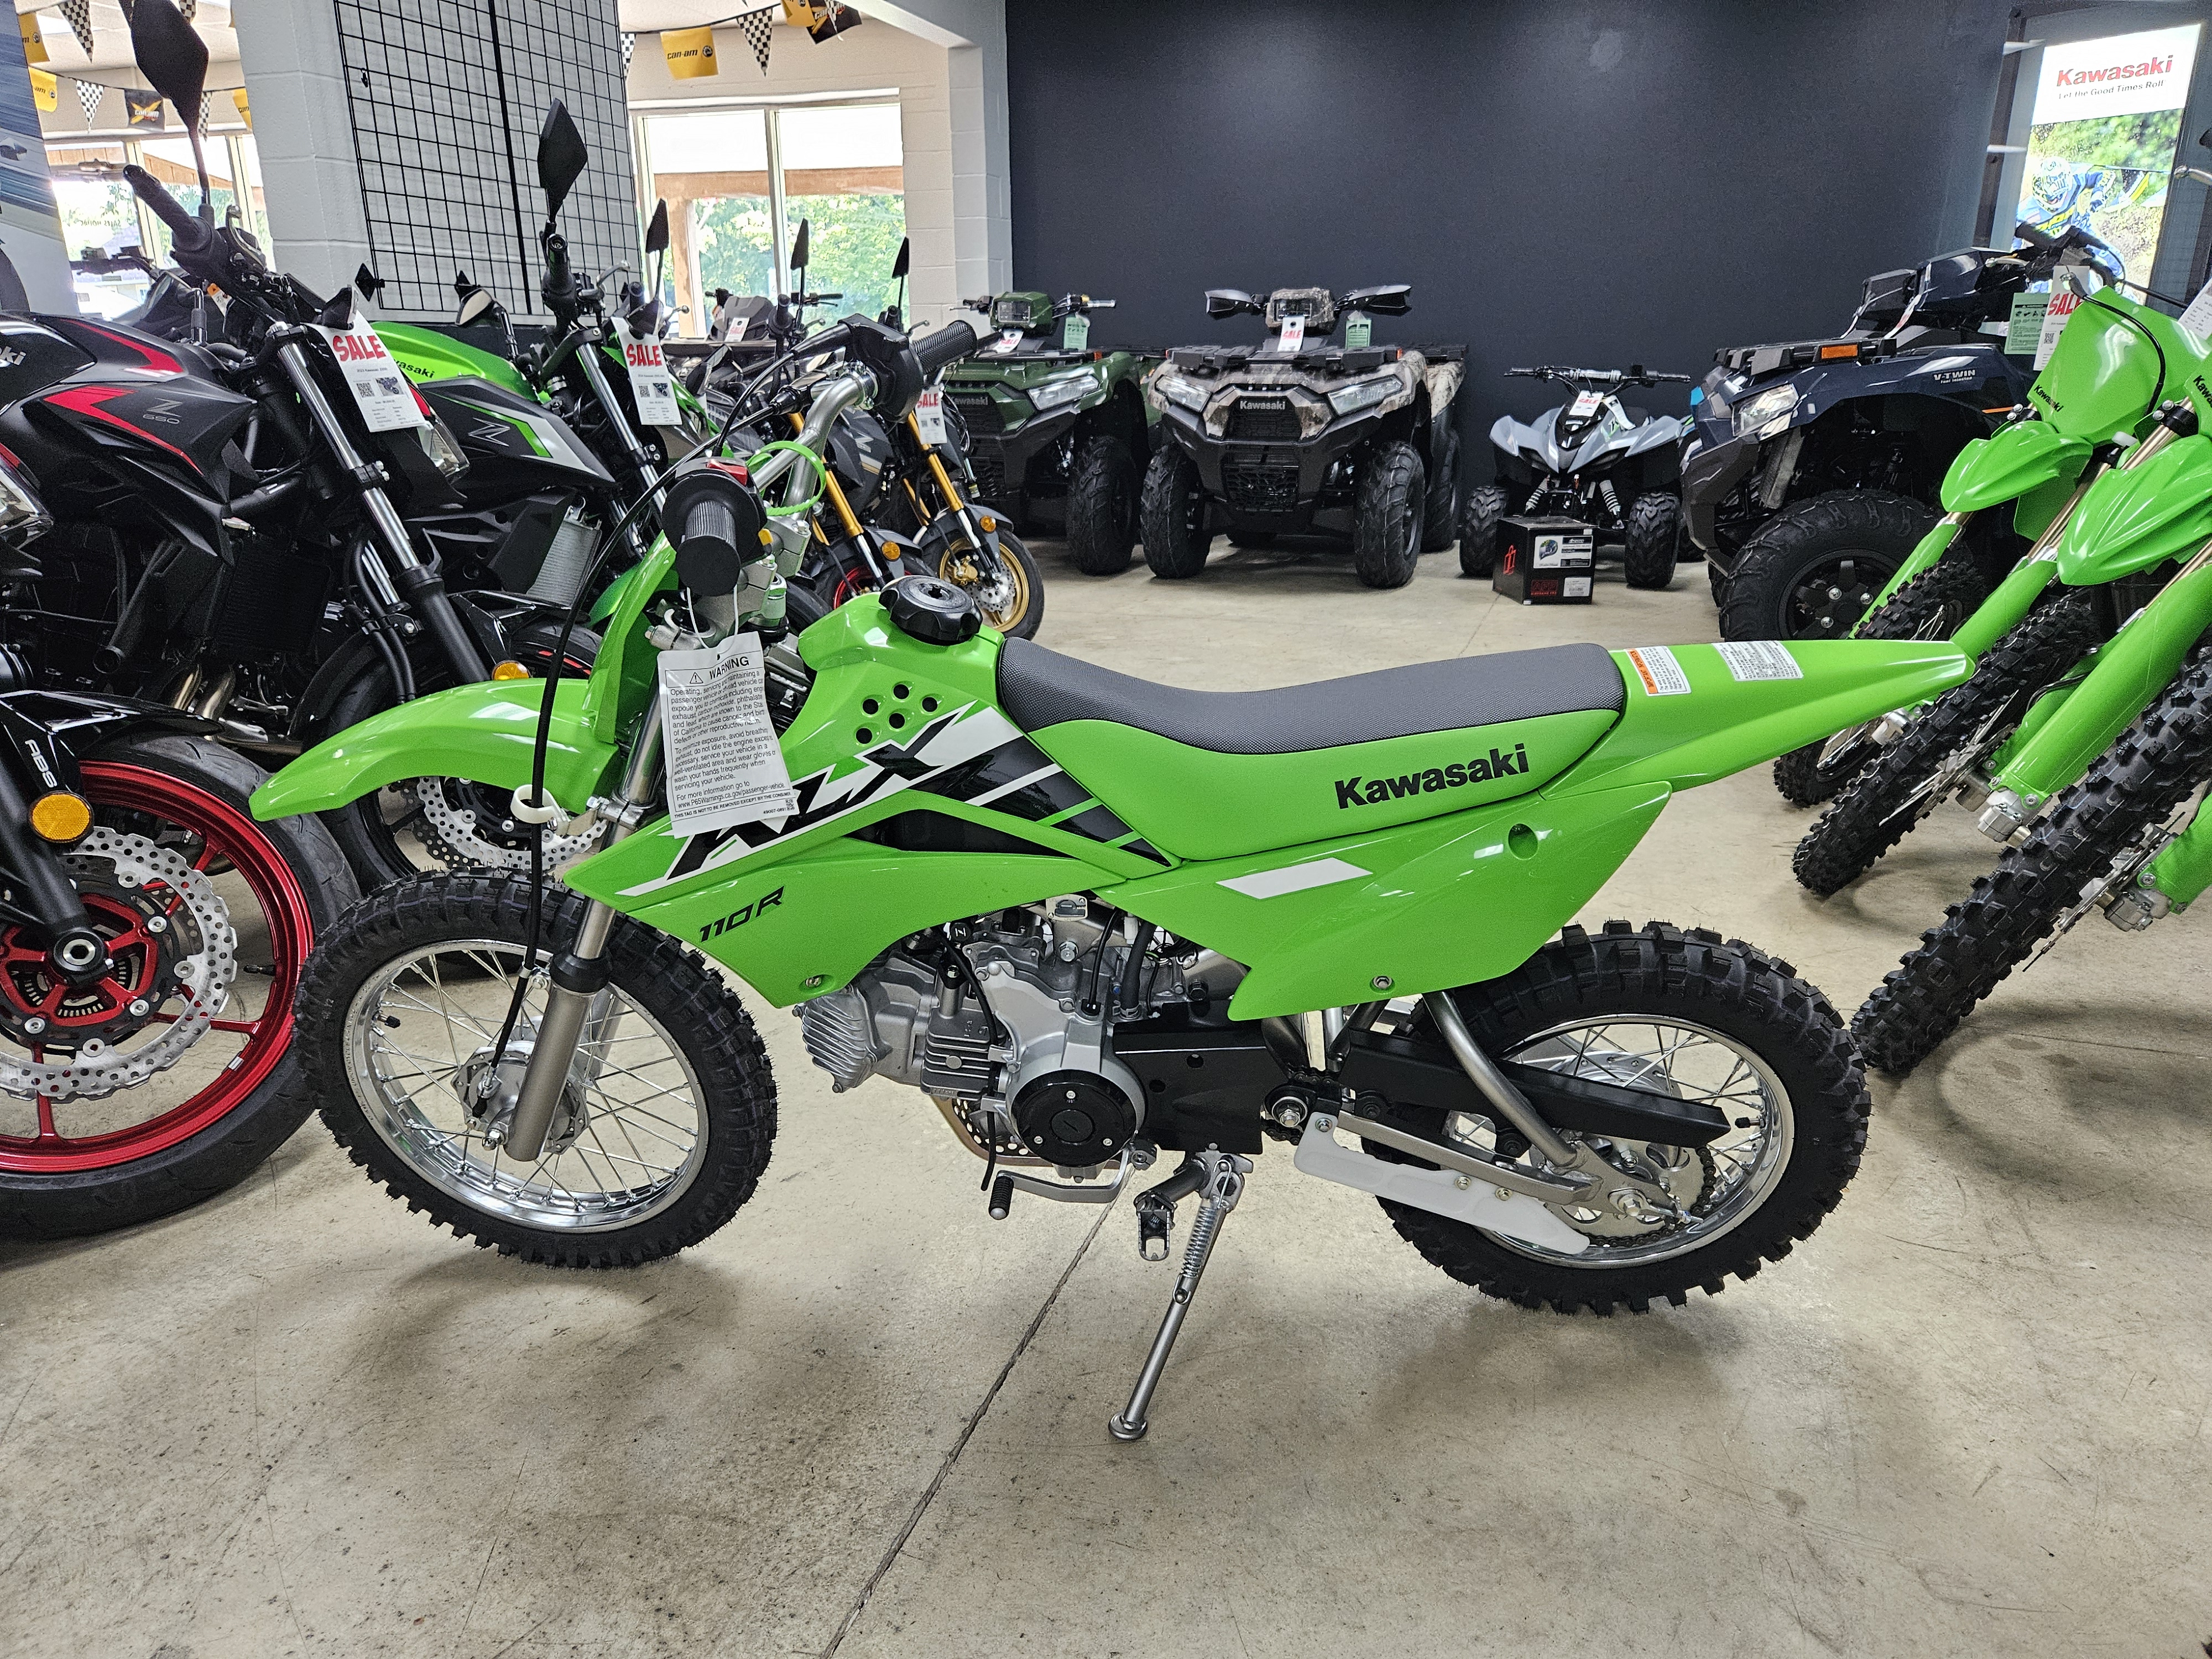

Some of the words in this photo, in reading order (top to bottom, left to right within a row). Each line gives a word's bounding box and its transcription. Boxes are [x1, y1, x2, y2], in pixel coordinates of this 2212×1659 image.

[666, 49, 698, 60] can-am
[2057, 55, 2174, 86] Kawasaki
[2091, 86, 2114, 95] Good
[2117, 84, 2143, 92] Times
[1282, 330, 1302, 340] SALE
[333, 335, 387, 362] SALE
[627, 343, 663, 367] SALE
[1934, 369, 1976, 381] V-TWIN
[916, 393, 940, 409] SALE
[1240, 400, 1286, 410] Kawasaki
[2033, 384, 2064, 413] Kawasaki
[143, 414, 180, 425] 650
[709, 656, 749, 680] WARNING
[671, 688, 702, 696] Operating,
[703, 682, 721, 693] servicing
[728, 671, 755, 684] maintaining
[671, 697, 702, 705] passenger
[703, 691, 717, 701] vehicle
[695, 703, 703, 711] you
[709, 694, 728, 705] chemicals
[728, 687, 753, 697] including
[698, 707, 713, 716] carbon
[698, 714, 710, 723] which
[719, 707, 735, 715] known
[674, 735, 691, 744] defects
[698, 728, 709, 737] other
[709, 722, 743, 734] reproductive
[681, 724, 702, 735] California
[682, 740, 701, 752] minimize
[702, 734, 728, 745] exposure,
[729, 731, 744, 739] avoid
[712, 742, 722, 750] idle
[723, 740, 732, 749] the
[733, 738, 753, 747] engine
[25, 739, 58, 788] ABS
[674, 763, 711, 775] well-ventilated
[753, 750, 771, 760] gloves
[675, 757, 700, 768] necessary,
[701, 752, 721, 761] service
[722, 749, 734, 759] your
[736, 744, 756, 753] vehicle
[674, 775, 688, 783] wash
[689, 772, 702, 781] your
[703, 768, 719, 776] hands
[721, 762, 749, 774] frequently
[750, 759, 766, 767] when
[1334, 743, 1530, 810] Kawasaki
[675, 781, 700, 791] servicing
[701, 778, 713, 787] your
[714, 773, 736, 783] vehicle.
[687, 791, 702, 800] more
[703, 784, 734, 796] information
[735, 782, 743, 791] go
[719, 800, 740, 808] REMOVED
[699, 886, 785, 942] 110R
